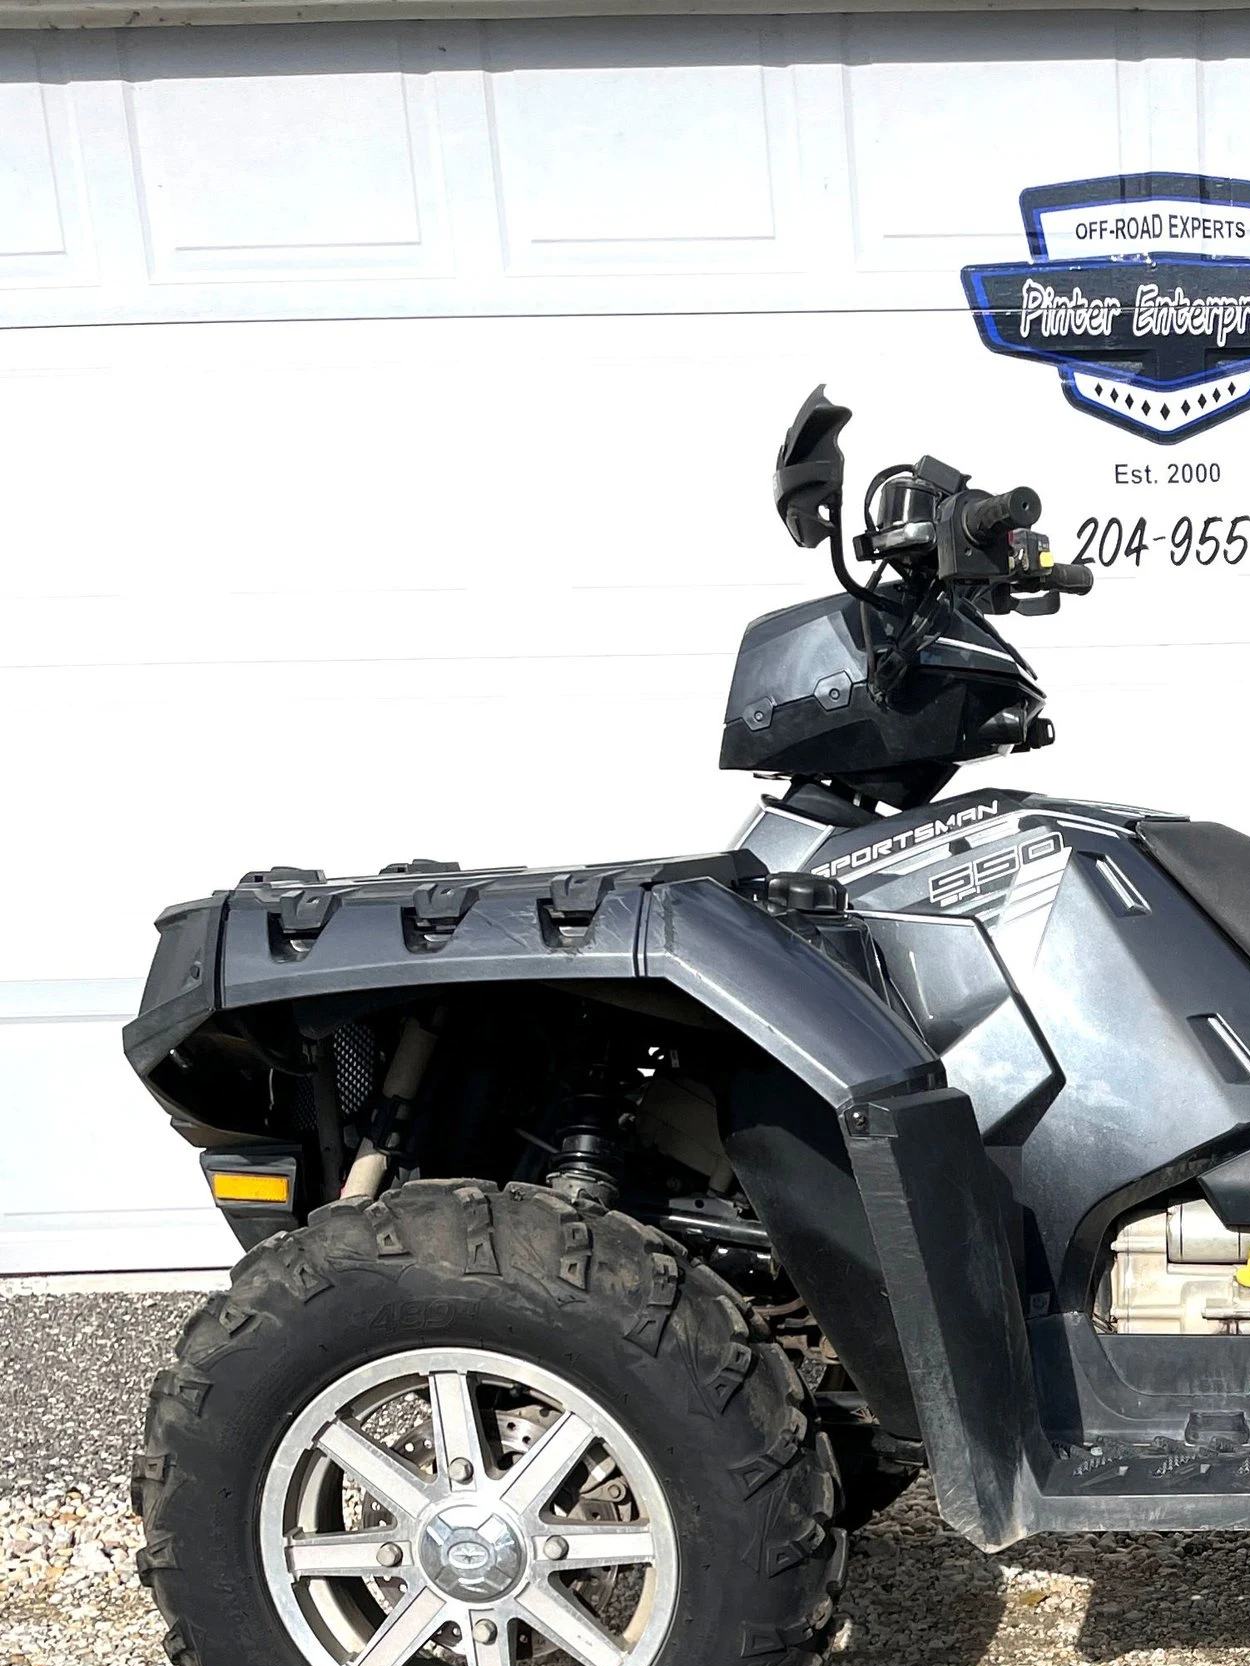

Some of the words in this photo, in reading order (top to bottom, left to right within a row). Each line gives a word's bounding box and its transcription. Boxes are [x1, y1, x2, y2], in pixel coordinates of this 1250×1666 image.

[1075, 213, 1163, 240] OFF-ROAD
[1169, 214, 1247, 240] EXPERTS
[1020, 278, 1122, 338] Pinter
[1114, 463, 1159, 485] Est.
[1167, 462, 1222, 484] 2000
[810, 799, 999, 879] SPORTSMAN
[928, 831, 1064, 904] 550
